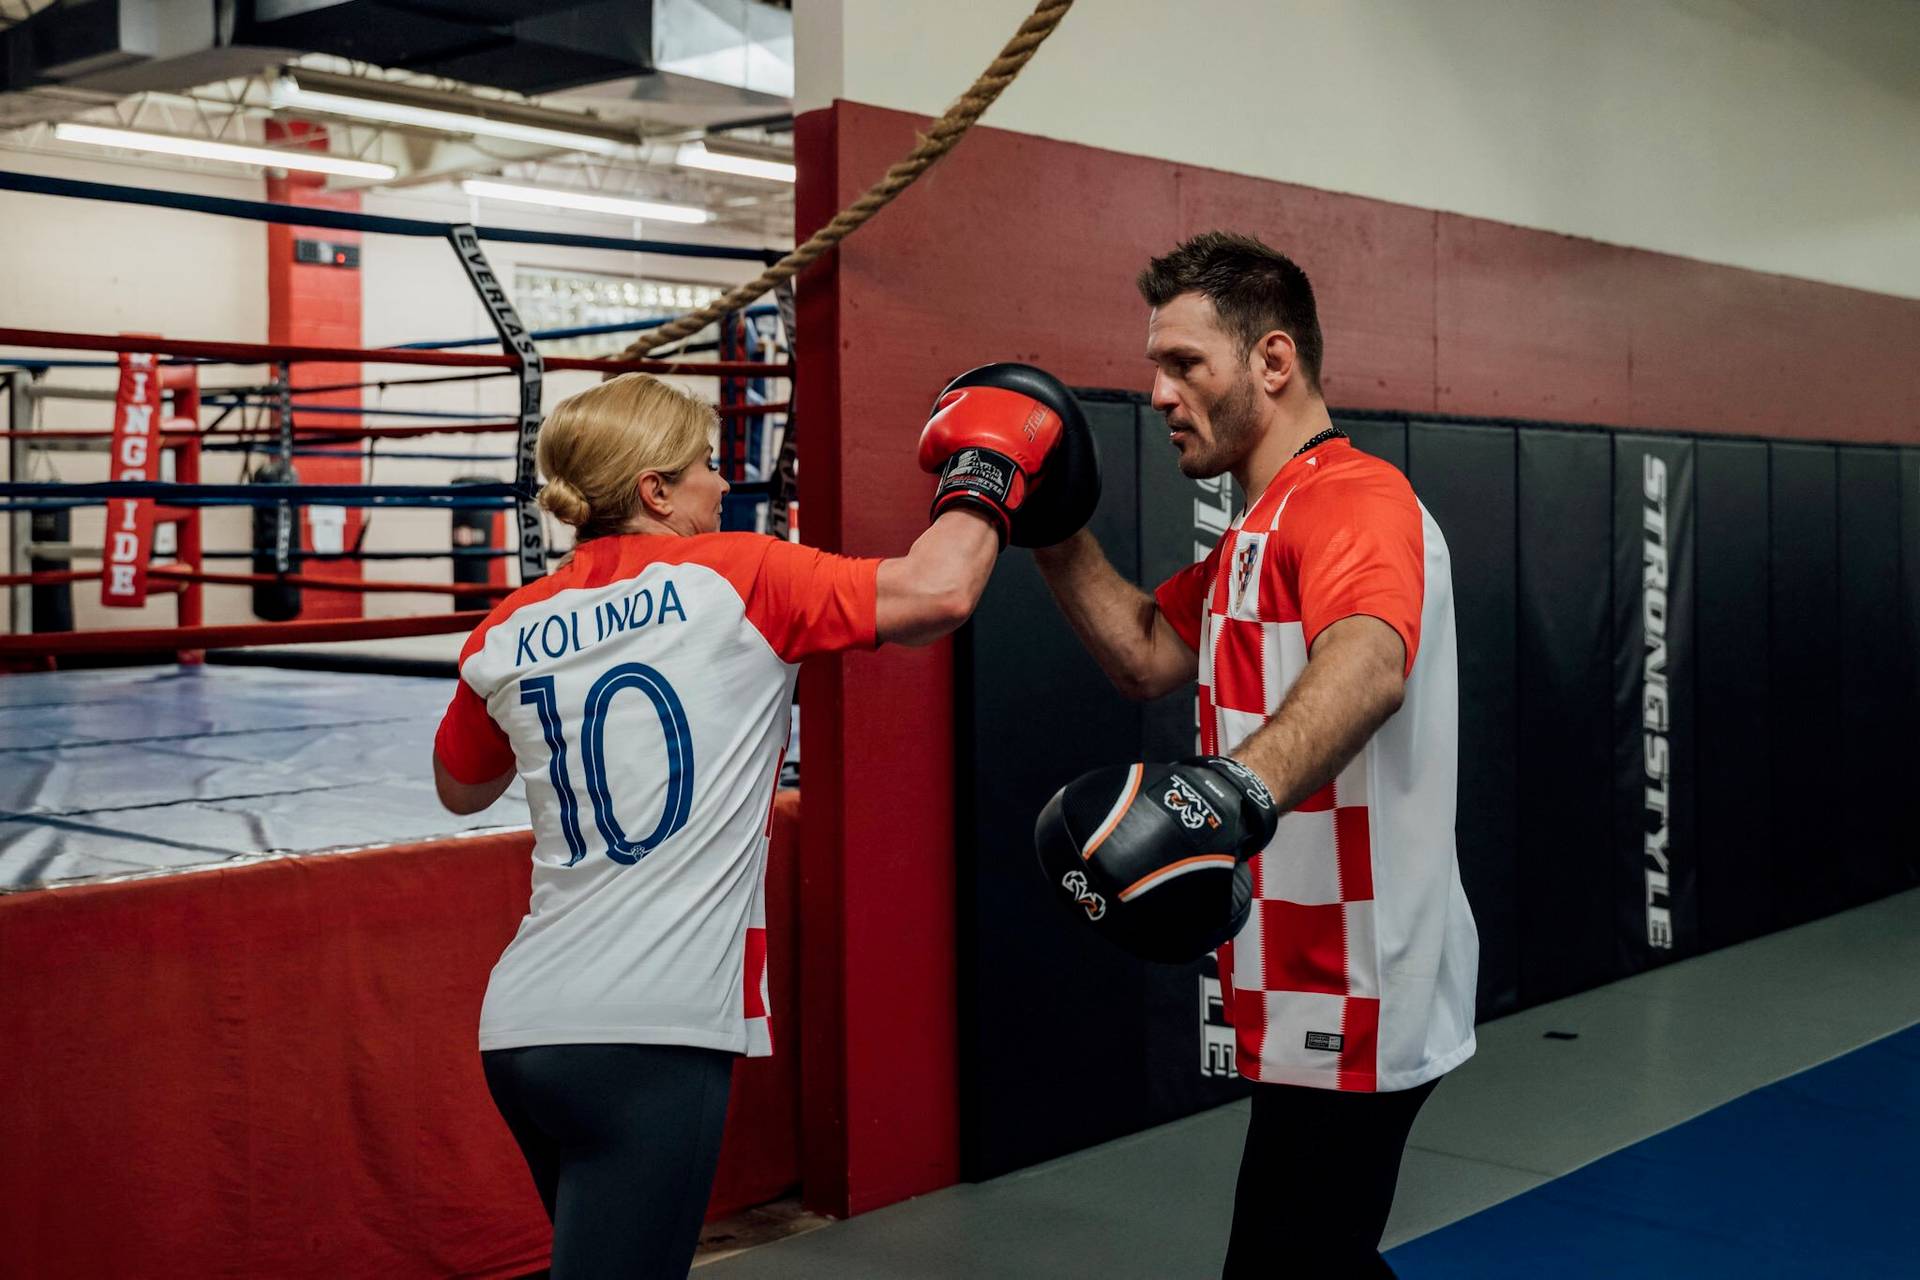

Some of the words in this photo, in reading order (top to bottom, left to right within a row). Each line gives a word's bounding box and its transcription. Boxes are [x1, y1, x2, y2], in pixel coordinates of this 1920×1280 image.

[458, 233, 541, 373] EVERLAST
[522, 421, 543, 571] EVEAST
[515, 580, 687, 666] KOLINDA
[519, 662, 694, 867] 10
[1642, 453, 1673, 950] STRONGSTYLE
